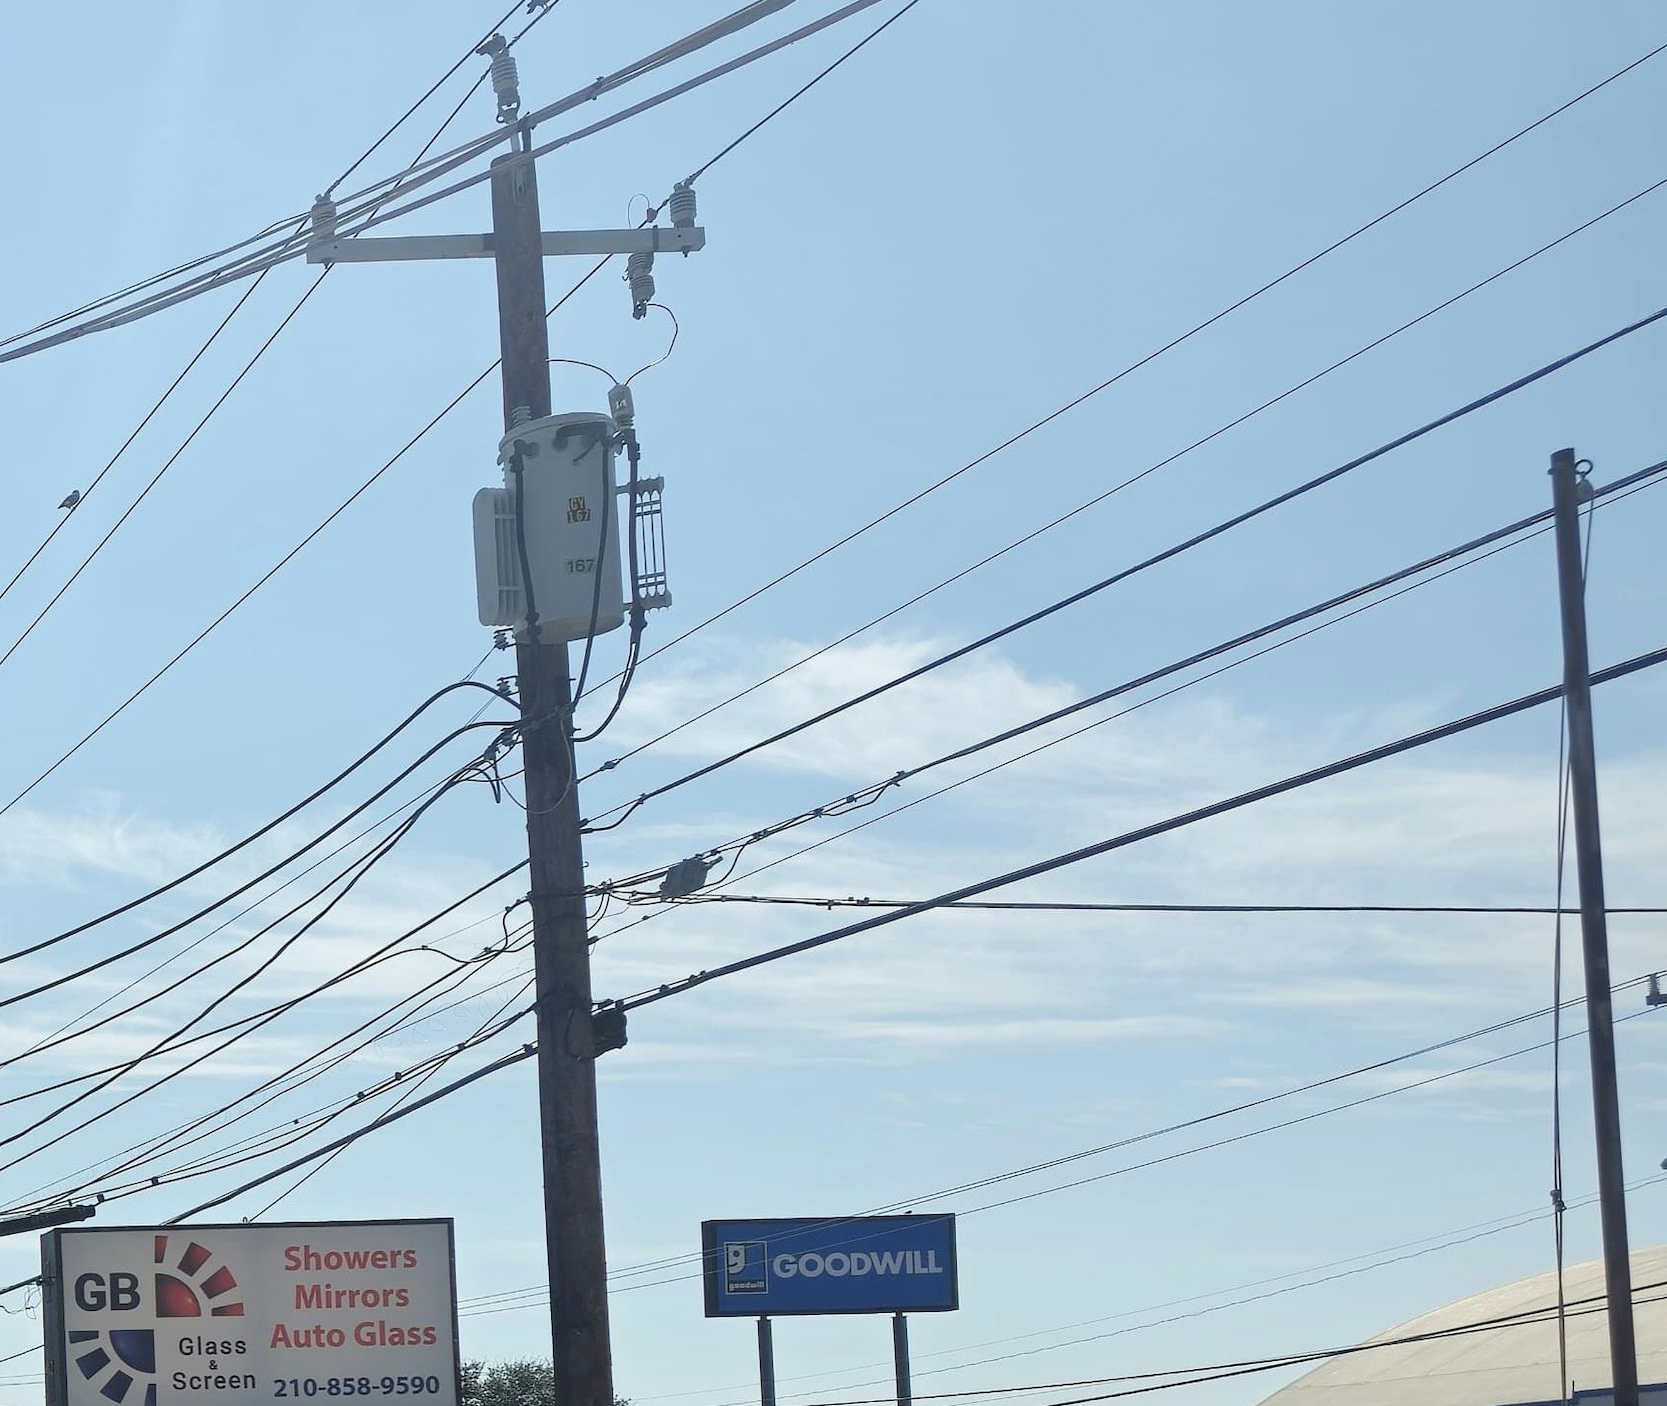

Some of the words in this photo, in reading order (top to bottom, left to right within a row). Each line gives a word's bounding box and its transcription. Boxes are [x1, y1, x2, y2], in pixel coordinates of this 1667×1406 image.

[567, 559, 594, 573] 167
[284, 1245, 417, 1272] Showers
[773, 1250, 943, 1278] GOODWILL
[74, 1272, 141, 1312] GB
[294, 1284, 410, 1310] Mirrors
[178, 1337, 247, 1356] Glass
[270, 1323, 345, 1349] Auto
[354, 1320, 437, 1347] Glass
[209, 1359, 218, 1370] &
[172, 1372, 256, 1391] Screen
[273, 1375, 440, 1398] 210-858-9590
